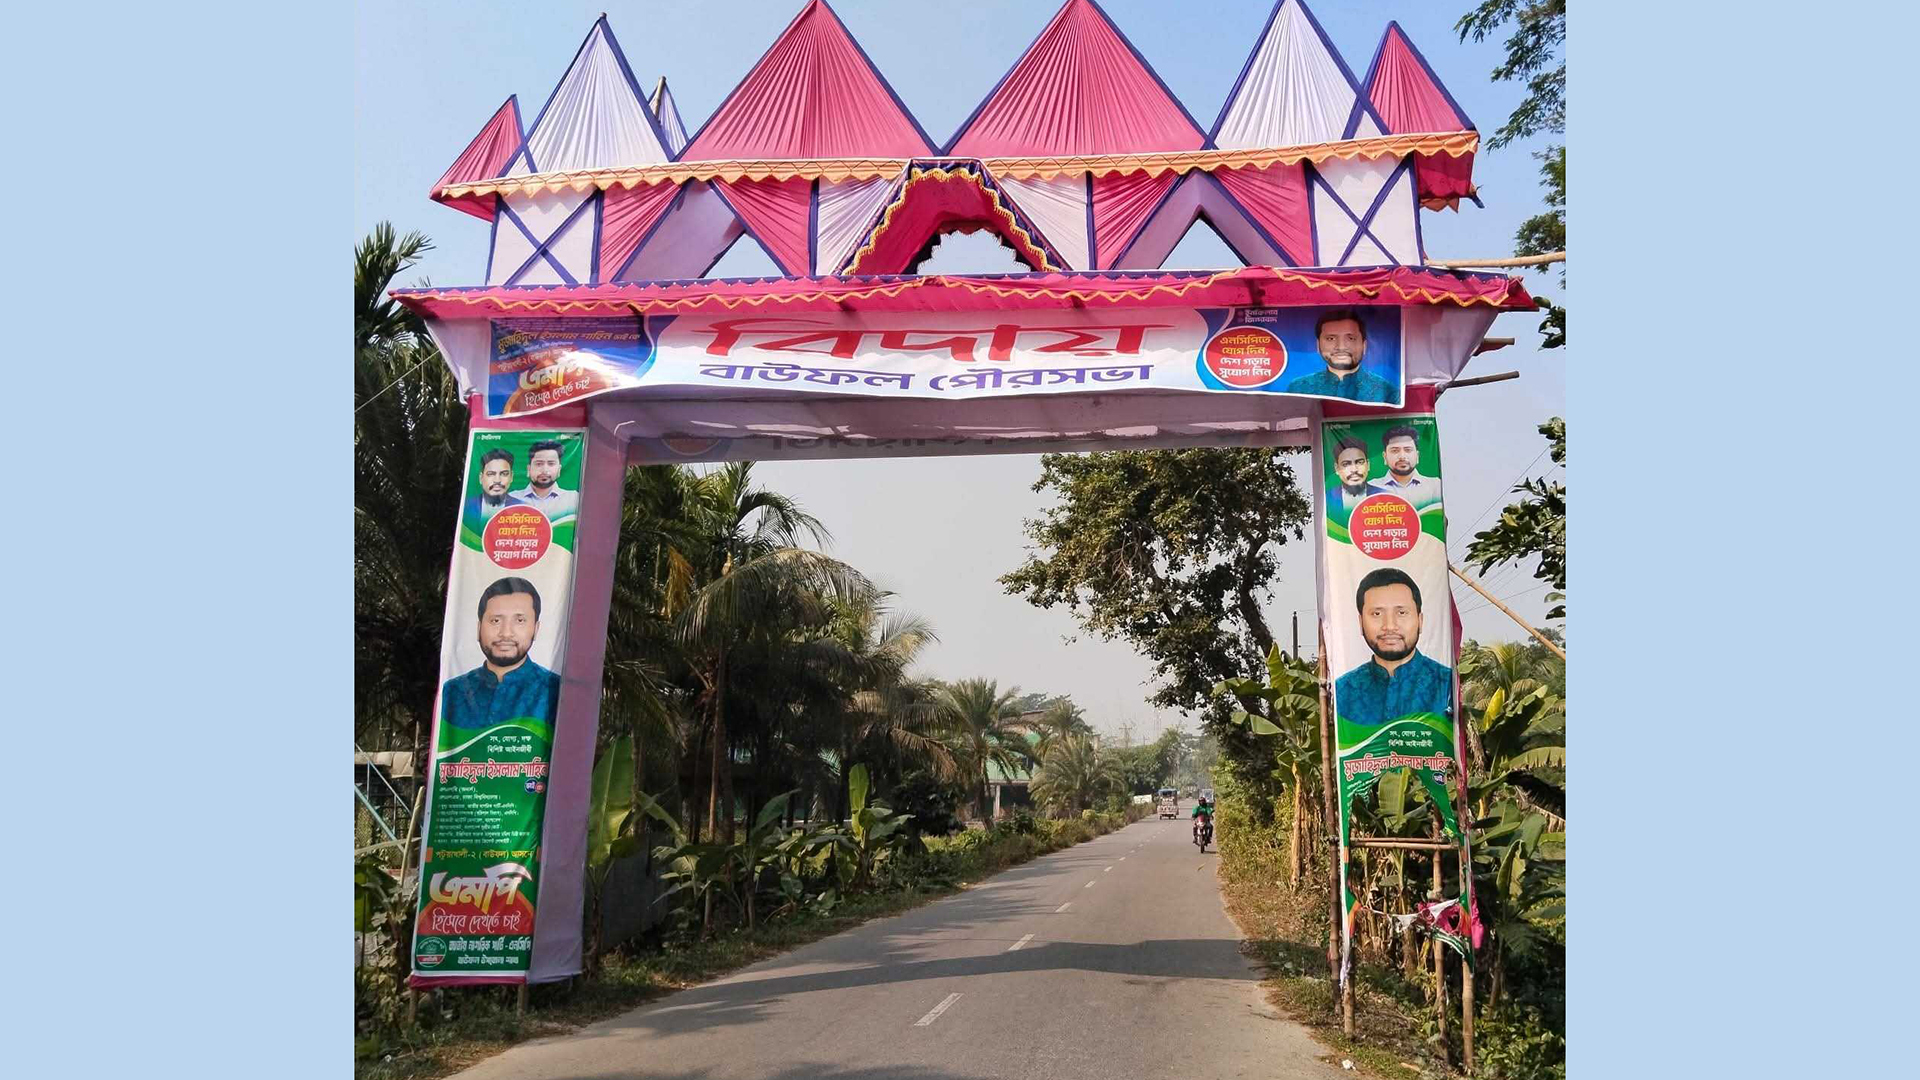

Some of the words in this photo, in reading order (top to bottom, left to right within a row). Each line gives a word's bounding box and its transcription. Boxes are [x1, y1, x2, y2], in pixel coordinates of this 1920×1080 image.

[691, 318, 1174, 361] বিদায়
[1220, 335, 1271, 345] এনসিপিতে
[1222, 347, 1244, 355] যোগ
[1246, 345, 1268, 356] দিন,
[1220, 357, 1241, 366] দেশ
[1243, 357, 1271, 368] গড়ার
[700, 362, 915, 391] বাউফল
[930, 365, 1154, 391] পৌরসভা
[1219, 368, 1250, 379] সুযোগ
[1252, 366, 1271, 376] নিন
[524, 389, 551, 407] হিসেবে
[576, 378, 591, 391] চাই
[1362, 503, 1407, 514] এনসিপিতে
[498, 513, 542, 525] এনসিপিতে
[1364, 517, 1384, 525] যোগ
[1385, 515, 1405, 526] দিন,
[498, 527, 518, 536] যোগ
[519, 525, 537, 537] দিন,
[1363, 528, 1382, 538] দেশ
[1383, 528, 1408, 539] গড়ার
[495, 538, 513, 548] দেশ
[515, 538, 538, 550] গড়ার
[1362, 541, 1390, 555] সুযোগ
[1392, 538, 1409, 550] নিন
[494, 550, 520, 562] সুযোগ
[521, 547, 538, 560] নিন
[439, 757, 487, 784] মুজাহিদুল
[487, 758, 520, 779] ইসলাম
[1343, 753, 1390, 781] মুজাহিদুল
[1389, 752, 1423, 771] ইসলাম
[429, 863, 532, 914] এমপি
[432, 907, 466, 934] হিসেবে
[469, 912, 501, 934] দেখতে
[503, 911, 522, 931] চাই
